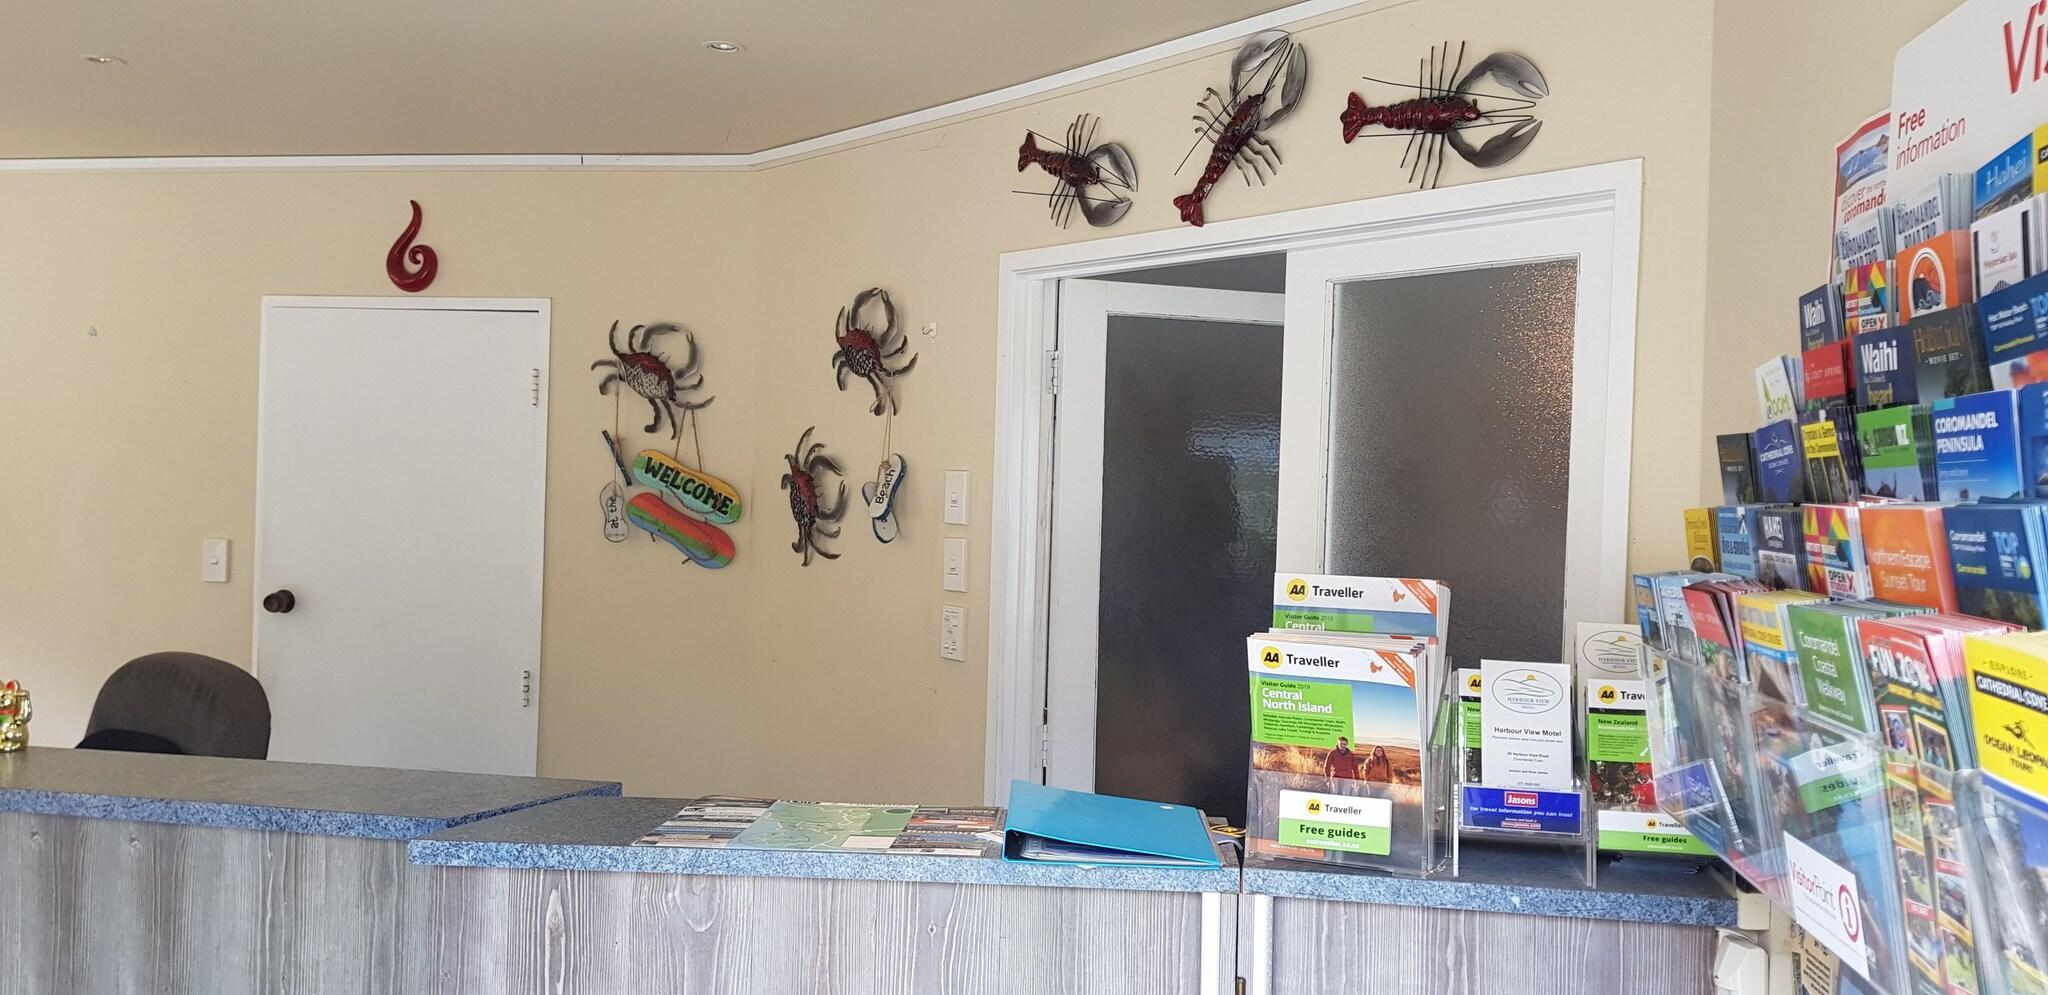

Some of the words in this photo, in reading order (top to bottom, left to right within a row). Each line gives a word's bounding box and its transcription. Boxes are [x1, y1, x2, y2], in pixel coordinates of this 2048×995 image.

[2003, 0, 2048, 94] Vi
[1898, 108, 1926, 139] Free
[1896, 117, 1966, 171] information
[1985, 149, 2028, 195] Hahei
[1843, 188, 1886, 224] coromand
[1804, 297, 1826, 329] Waihi
[1860, 340, 1898, 374] Waihi
[1935, 411, 1999, 434] COROMANDEL
[1936, 435, 1984, 454] PENINSULA
[645, 456, 735, 517] WELCOME
[874, 468, 896, 505] Beach
[608, 496, 618, 513] the
[610, 515, 619, 529] at
[1289, 583, 1306, 596] AA
[1312, 586, 1365, 600] Traveller
[1285, 620, 1326, 632] Central
[1799, 631, 1840, 657] Coromandel
[1263, 652, 1281, 663] AA
[1286, 653, 1341, 669] Traveller
[1868, 644, 1898, 680] FUN
[1262, 688, 1302, 700] Central
[1508, 696, 1535, 704] HARBOUR
[1600, 690, 1615, 699] AA
[1976, 674, 2024, 703] CATHEDRAL
[2022, 689, 2048, 713] COVE
[1263, 699, 1296, 711] North
[1298, 702, 1333, 714] Island
[1494, 726, 1522, 735] Harbour
[1523, 728, 1541, 736] View
[1542, 729, 1562, 737] Motel
[1507, 794, 1536, 804] Jasons
[1324, 804, 1362, 815] Traveller
[1299, 824, 1325, 835] Free
[1327, 827, 1367, 839] guides
[1642, 835, 1661, 843] Free
[1661, 836, 1688, 845] guides
